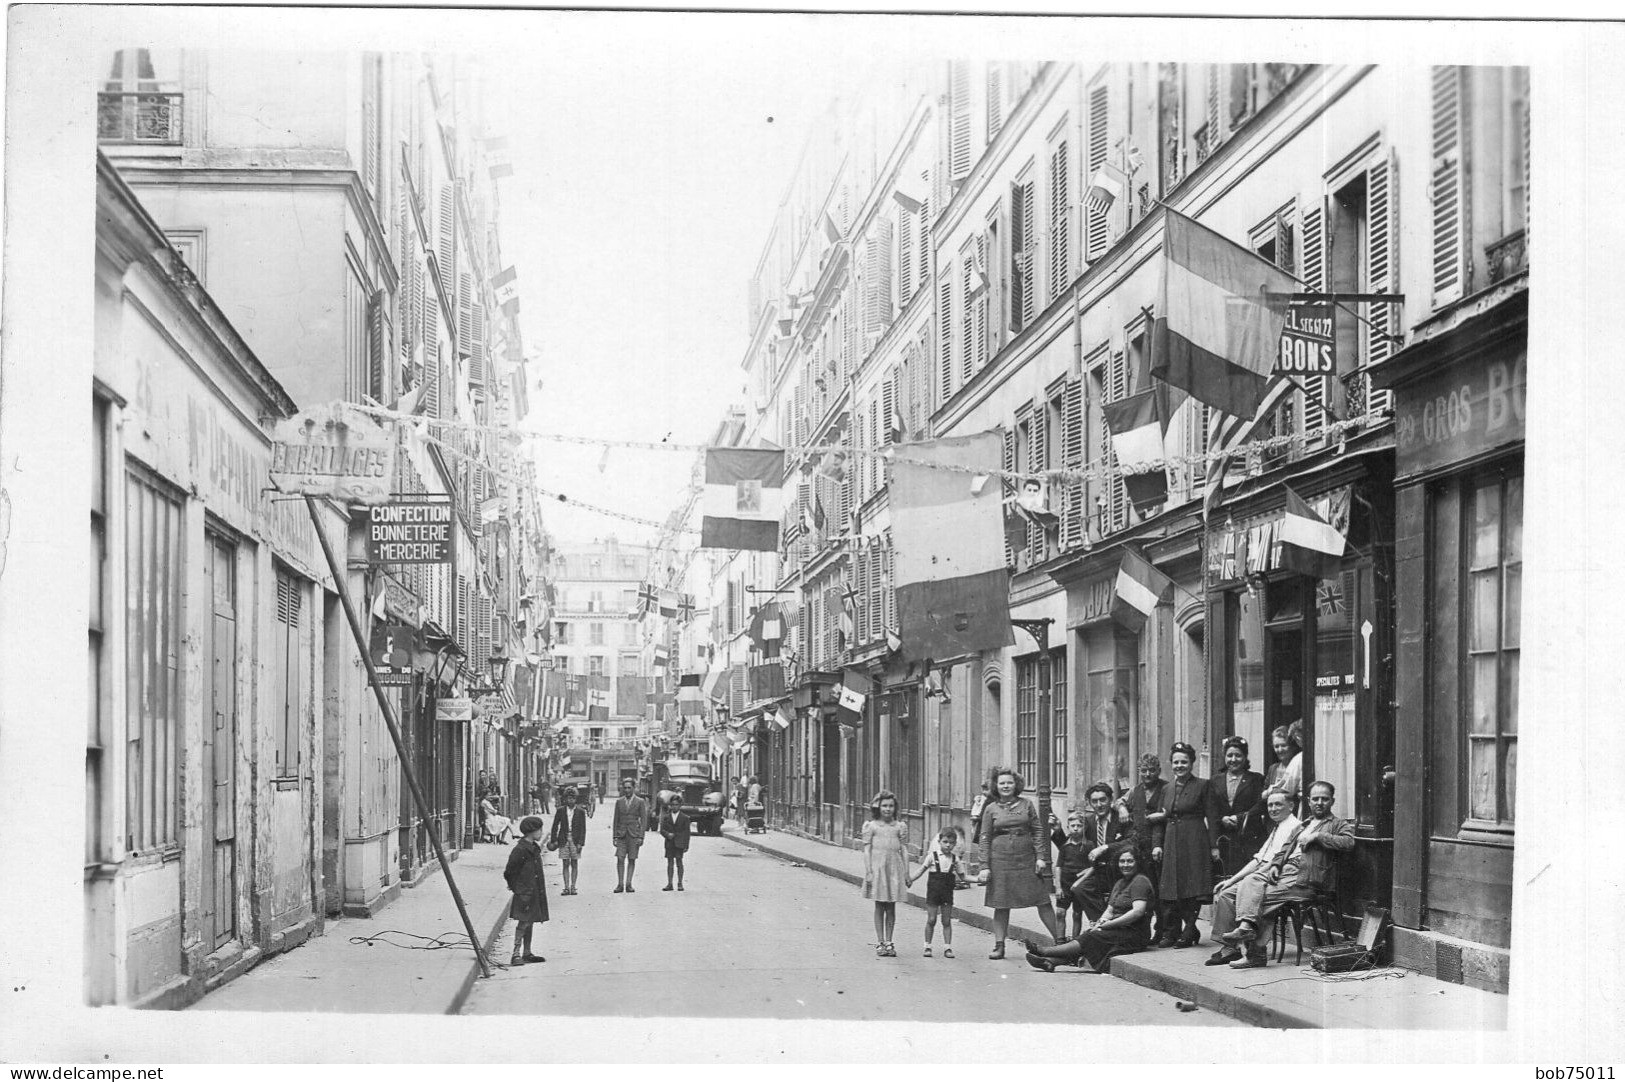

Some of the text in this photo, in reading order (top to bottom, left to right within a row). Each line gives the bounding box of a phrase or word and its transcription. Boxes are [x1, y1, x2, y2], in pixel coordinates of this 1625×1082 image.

[1423, 384, 1472, 446] GROS
[371, 506, 451, 522] CONFECTION
[372, 524, 450, 541] BONNETERIE
[401, 666, 412, 674] DU
